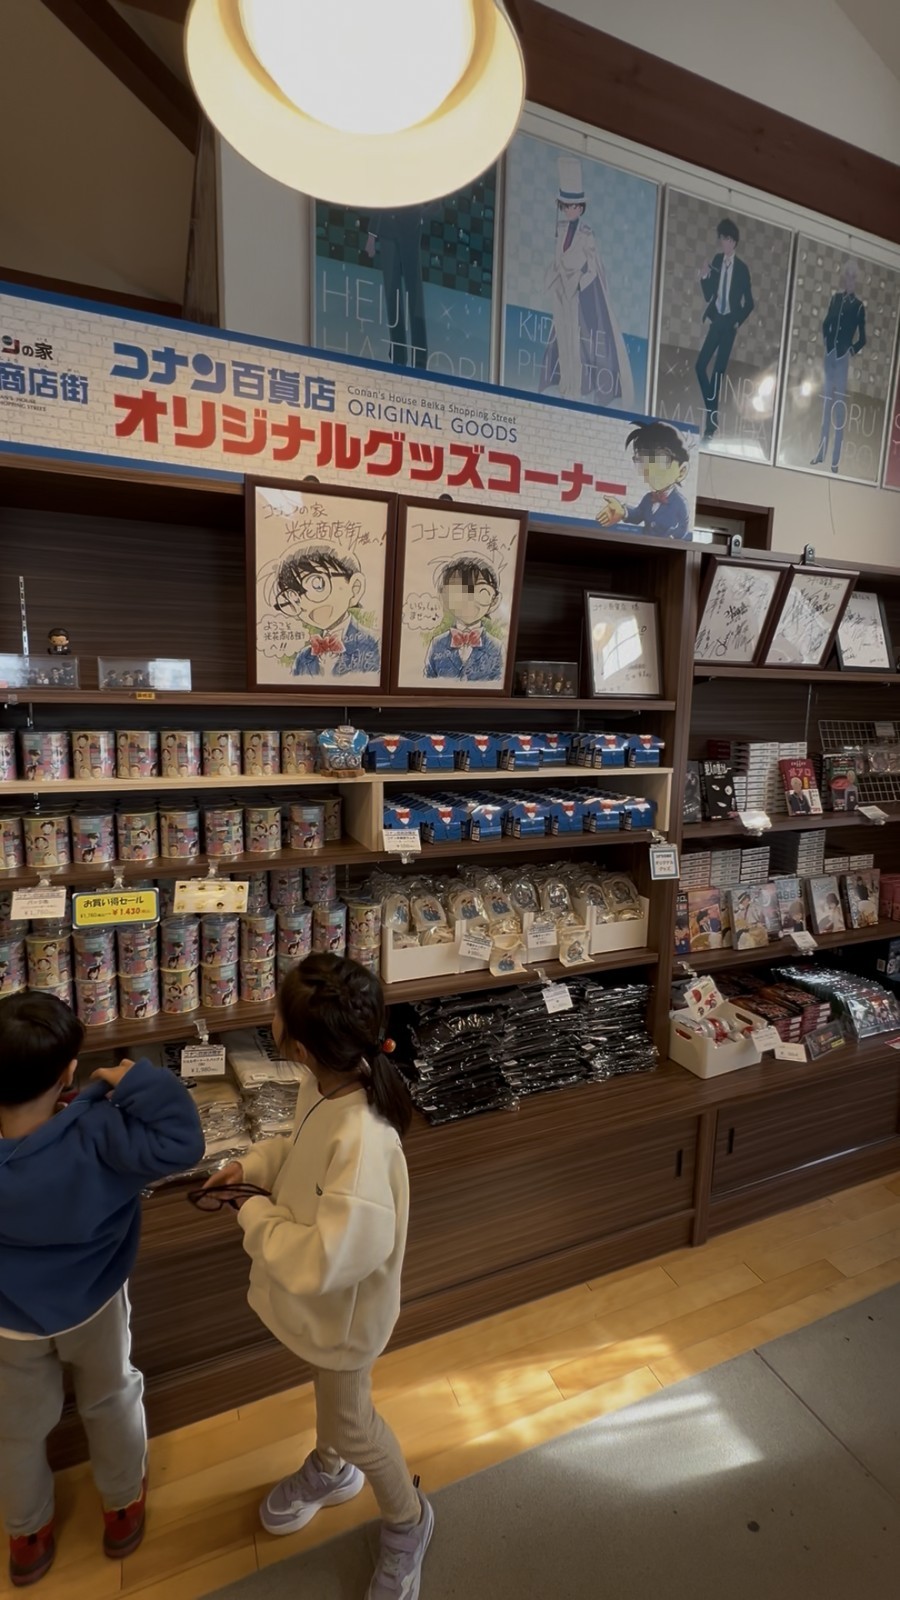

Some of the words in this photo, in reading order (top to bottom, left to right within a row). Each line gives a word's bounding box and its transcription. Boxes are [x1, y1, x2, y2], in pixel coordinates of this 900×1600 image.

[323, 270, 410, 331] HEIJI
[519, 310, 558, 345] KID
[0, 362, 88, 404] 商店街
[110, 342, 336, 413] コナン百貨店
[347, 385, 385, 400] Conan's
[388, 392, 417, 406] House
[448, 403, 489, 421] Shopping
[491, 412, 517, 425] Street
[348, 399, 442, 430] ORIGINAL
[451, 417, 518, 443] GOODS
[114, 390, 627, 502] オリジナルグッズコーナー
[83, 896, 144, 908] お買い得セール
